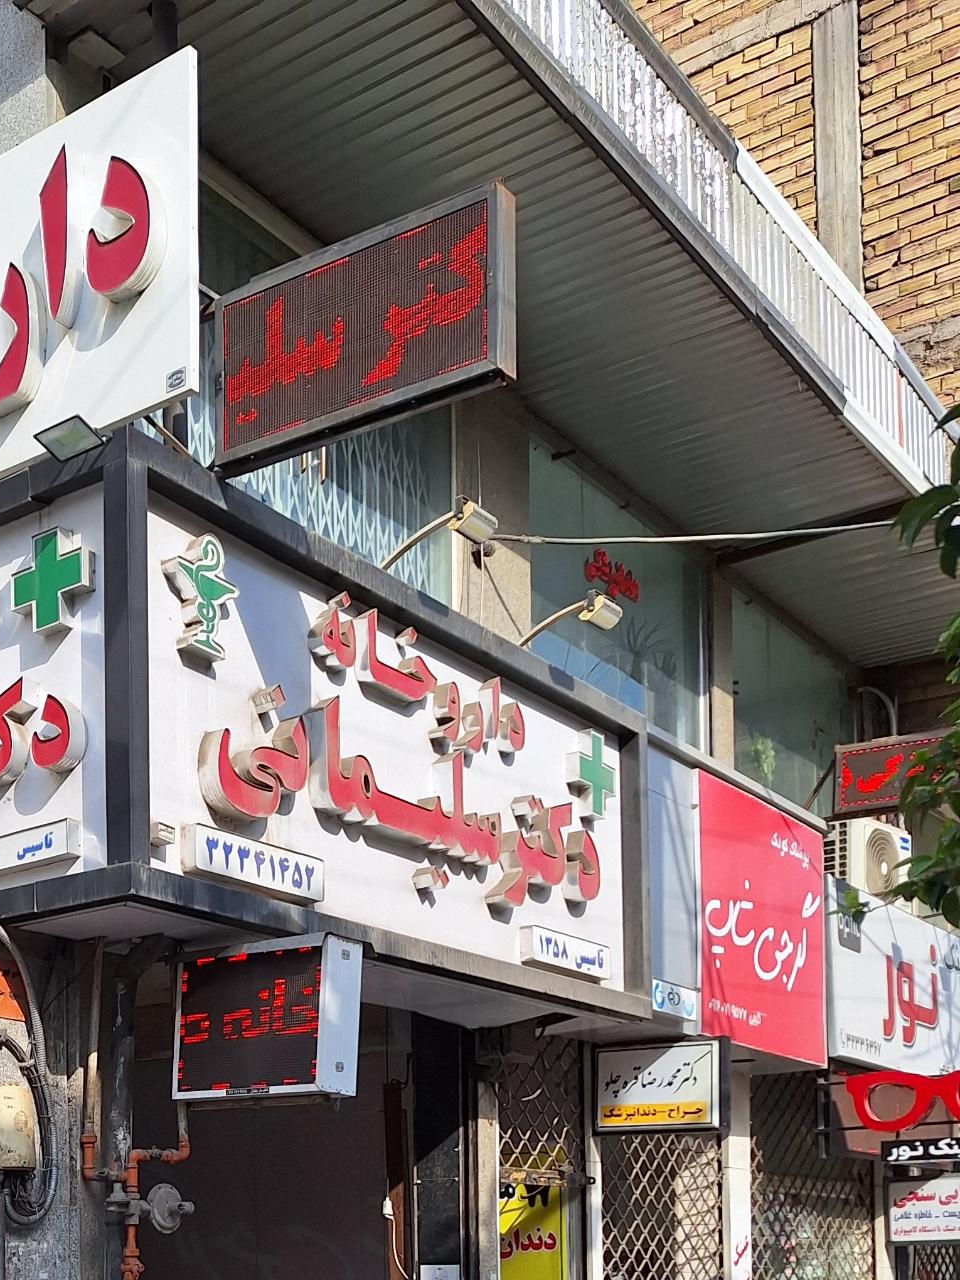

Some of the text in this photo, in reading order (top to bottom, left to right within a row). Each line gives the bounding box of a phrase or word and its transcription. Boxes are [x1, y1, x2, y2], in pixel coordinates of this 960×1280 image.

[314, 591, 526, 755] داروخانه
[202, 684, 602, 908] دکتر سلیمانی
[205, 835, 315, 892] ۳۲۳۴۱۴۵۲
[539, 933, 569, 960] ۱۳۵۸
[882, 943, 939, 1047] نور
[886, 1137, 960, 1161] ینک نور
